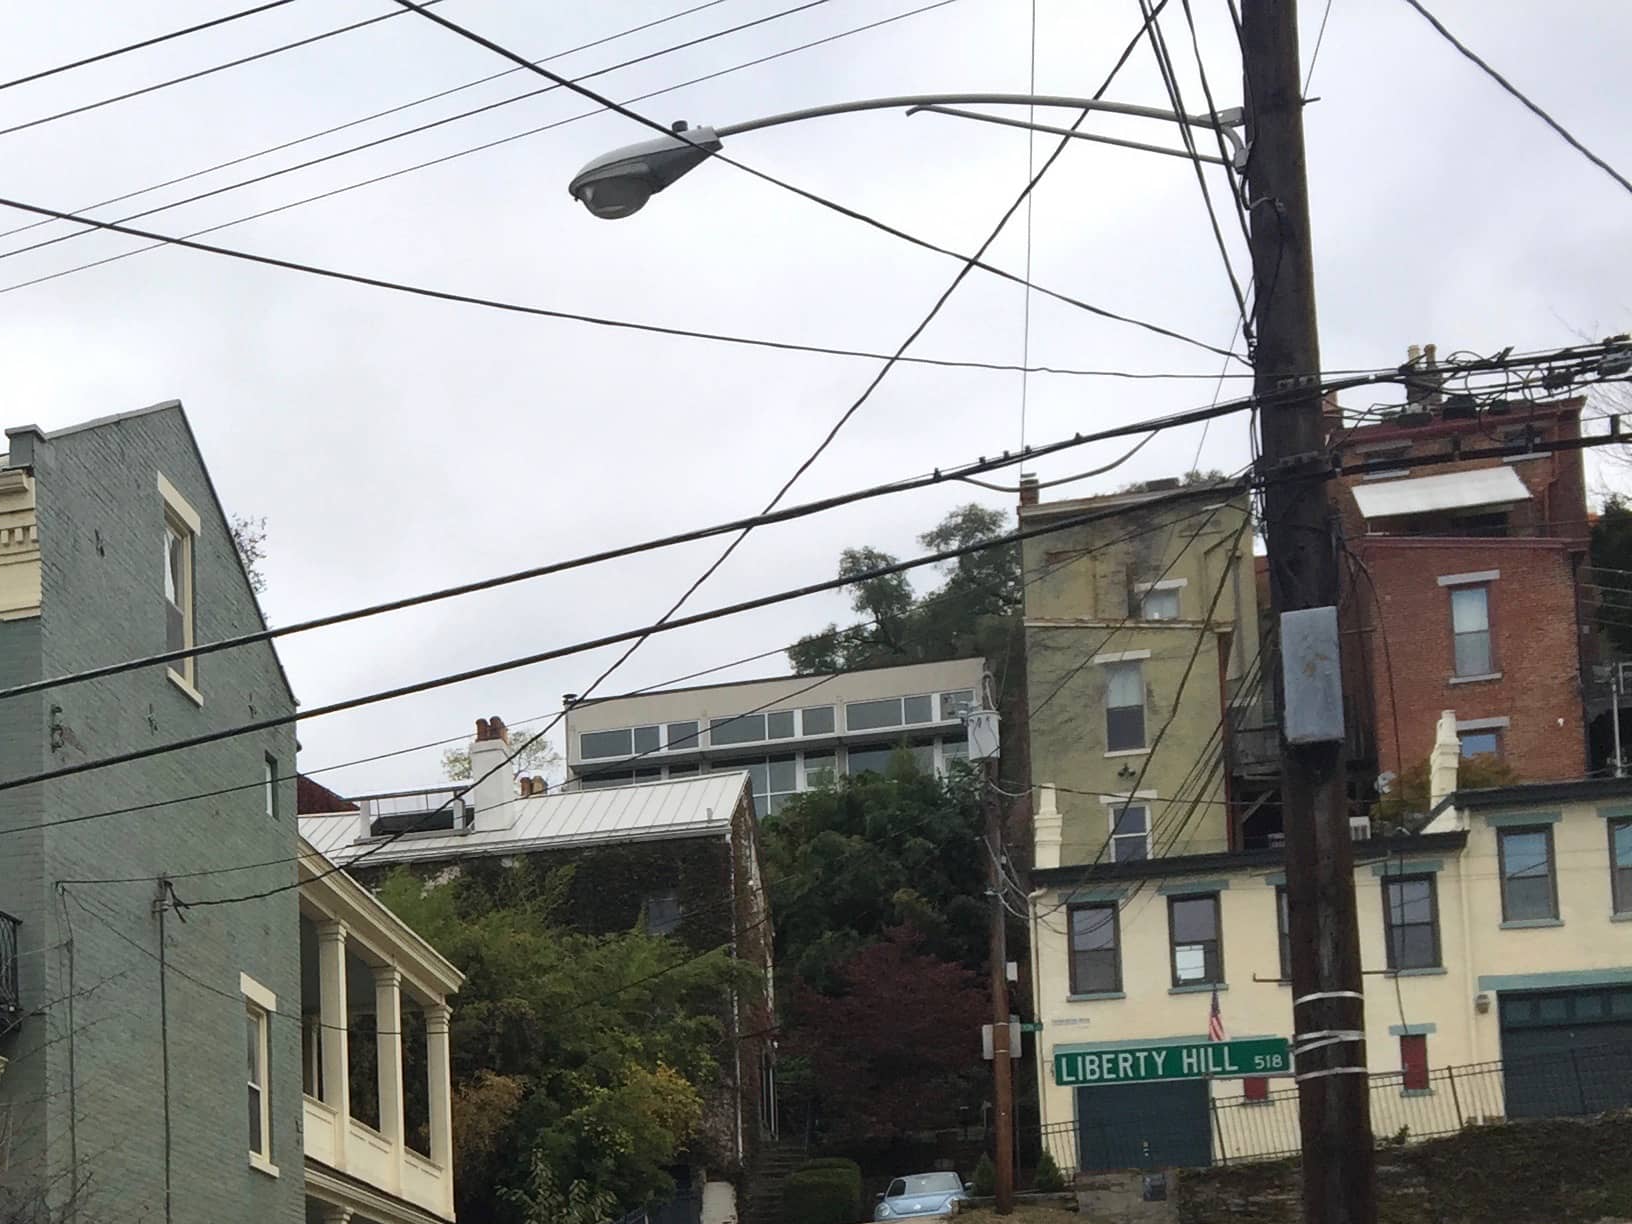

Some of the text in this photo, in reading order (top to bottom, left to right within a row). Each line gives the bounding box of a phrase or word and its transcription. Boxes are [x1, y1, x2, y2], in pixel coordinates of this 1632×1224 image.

[1061, 1046, 1283, 1082] LIBERTY HILL 518
